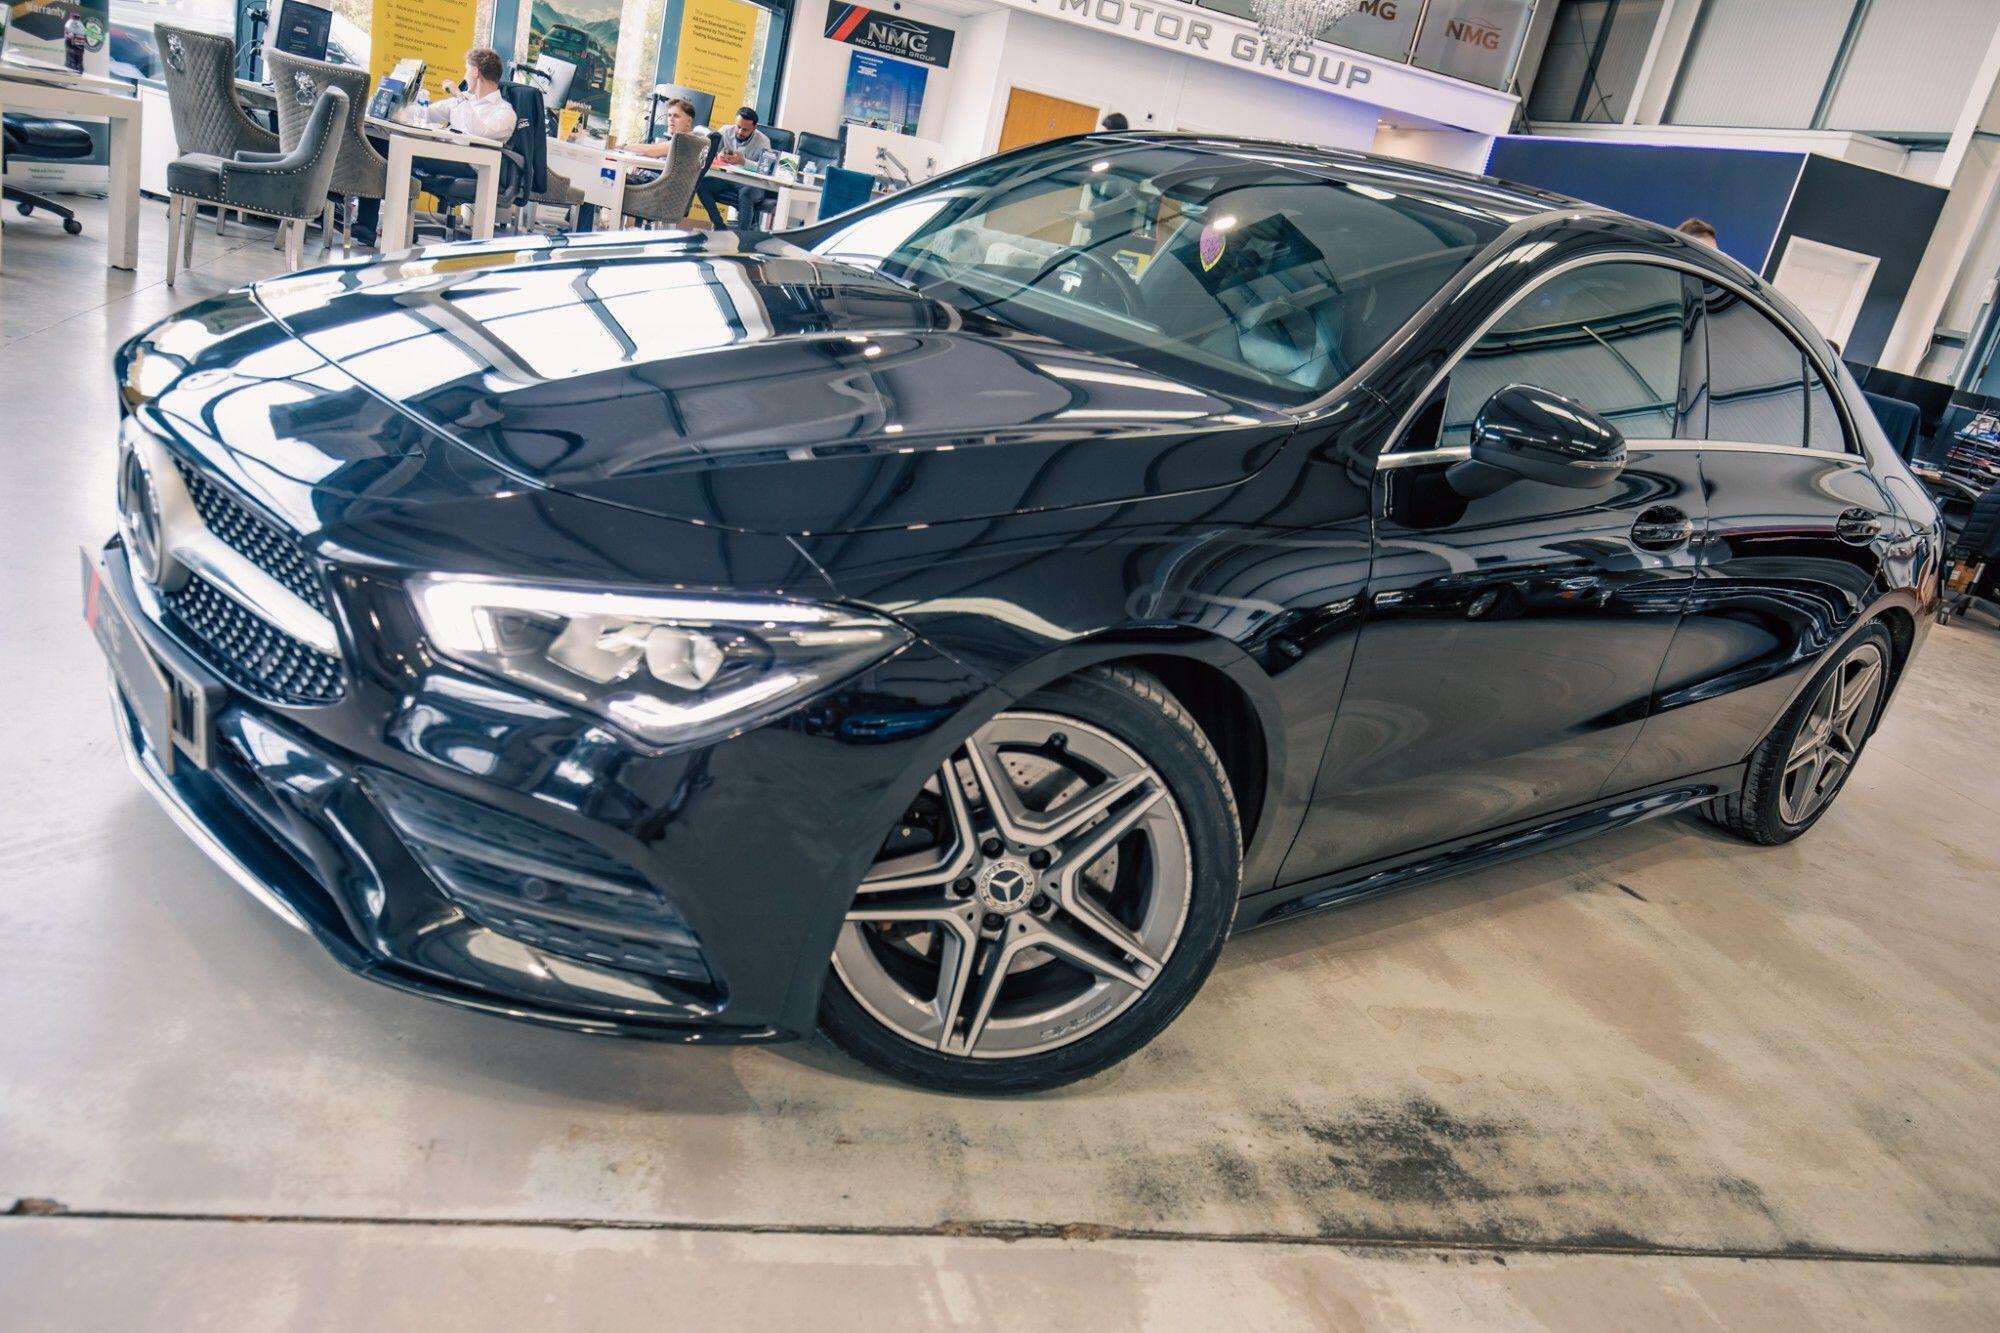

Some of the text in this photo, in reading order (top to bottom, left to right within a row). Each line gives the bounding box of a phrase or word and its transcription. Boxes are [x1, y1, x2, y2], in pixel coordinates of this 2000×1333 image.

[1059, 0, 1213, 50] MOTOR
[1358, 0, 1397, 20] MG
[867, 22, 929, 53] NMG
[1445, 20, 1500, 50] NMG
[878, 44, 907, 56] MOTOR
[908, 51, 937, 62] GROUP
